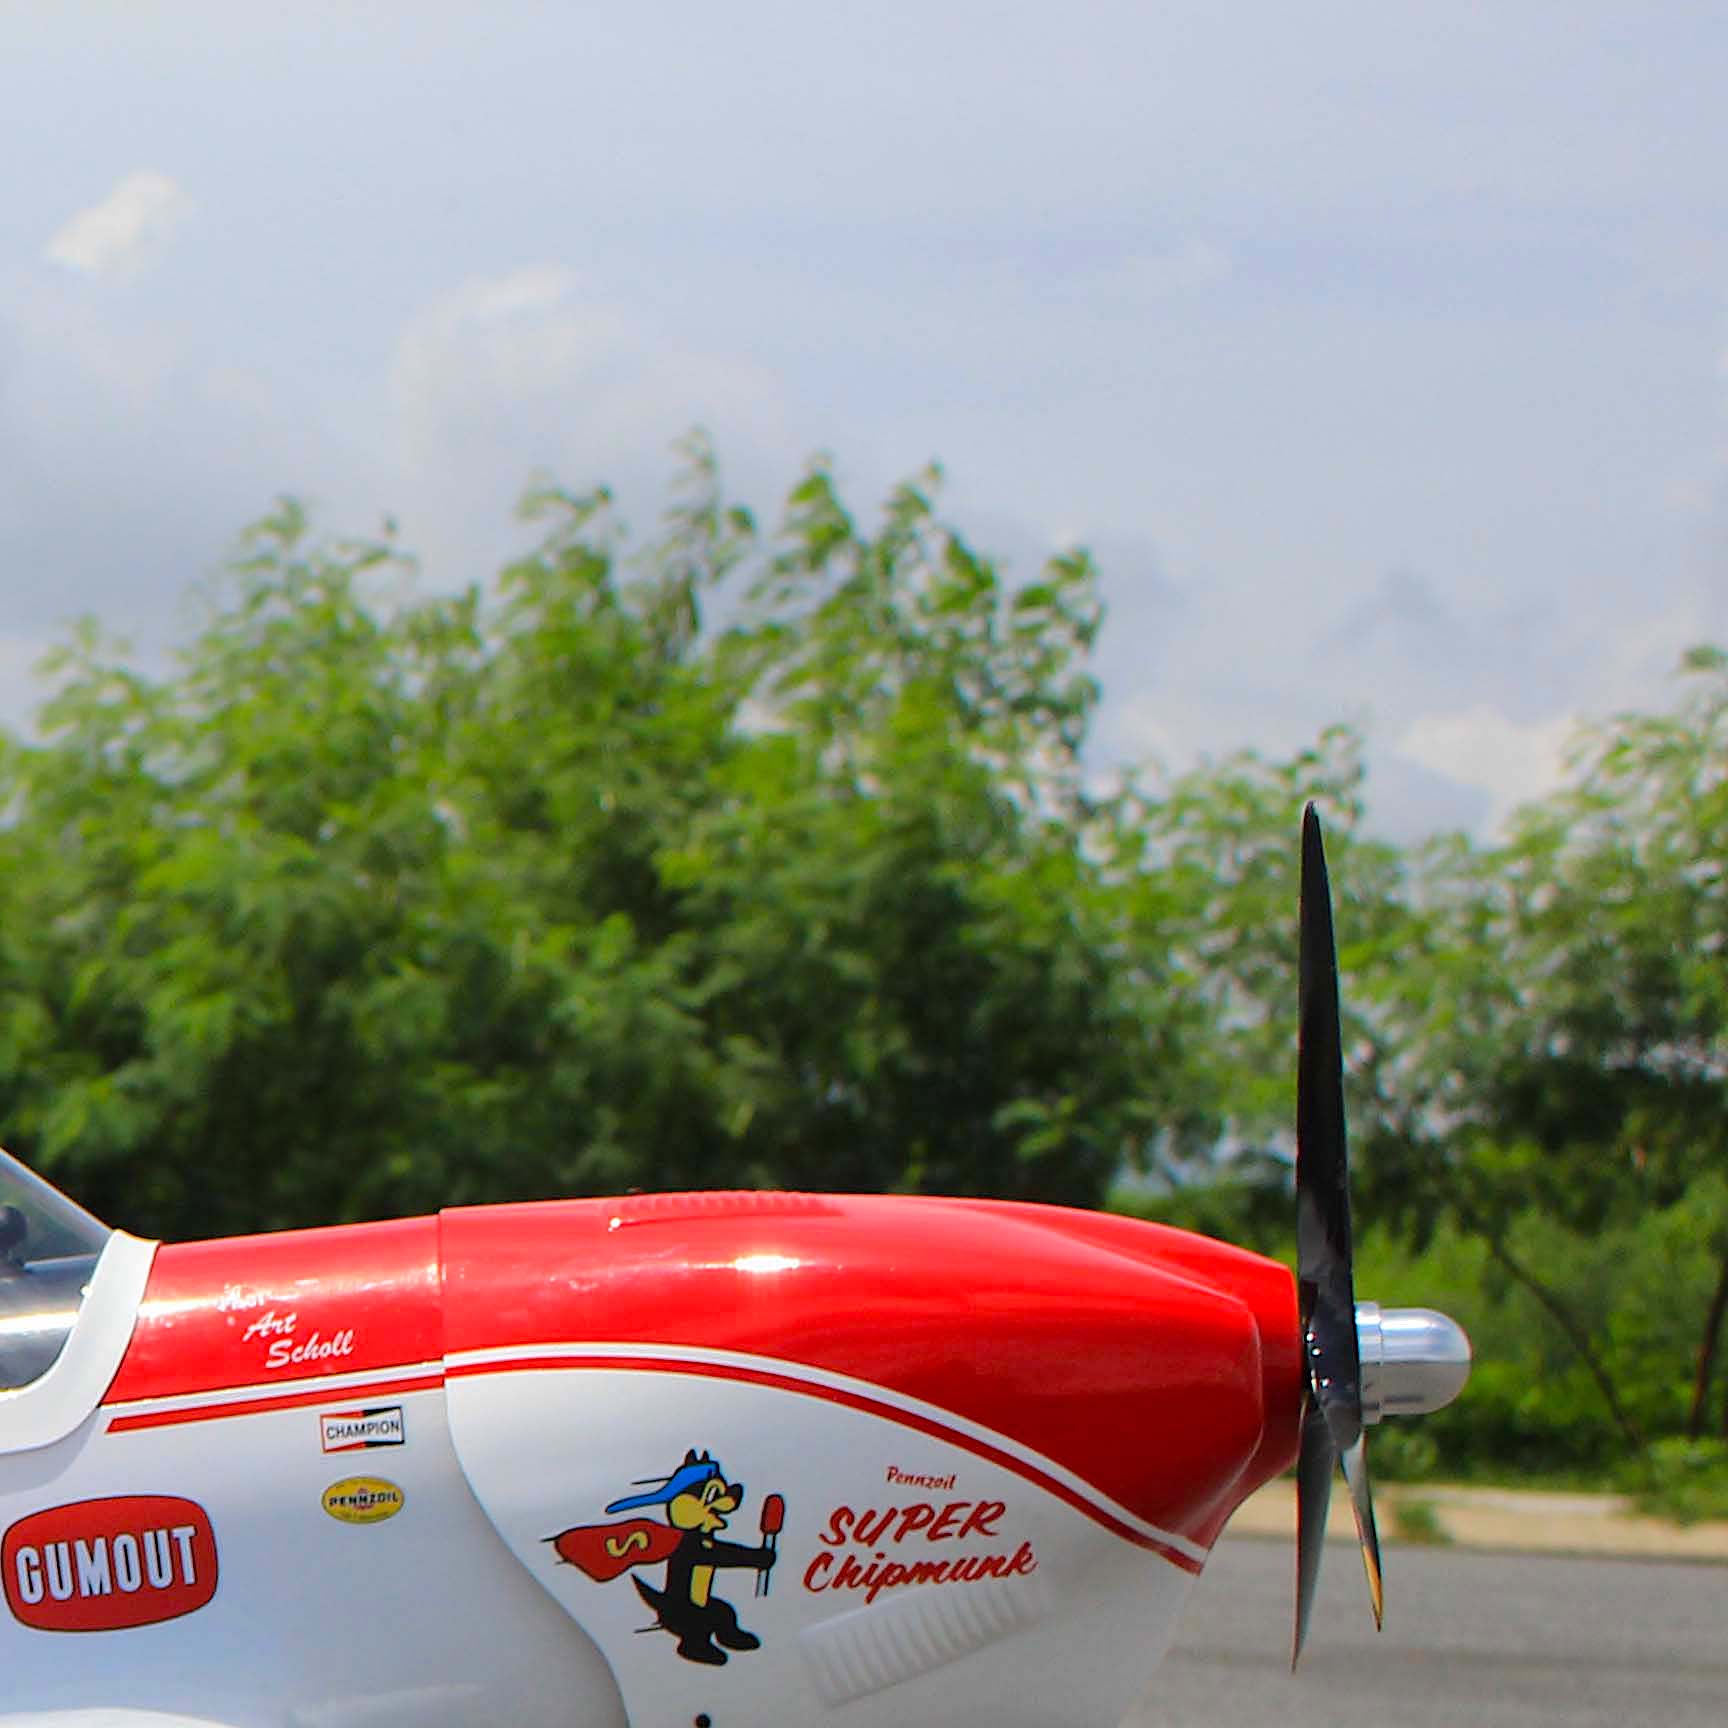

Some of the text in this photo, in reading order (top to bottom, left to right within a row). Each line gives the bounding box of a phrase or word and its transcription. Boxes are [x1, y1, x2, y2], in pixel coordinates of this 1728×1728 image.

[242, 1311, 297, 1341] Art
[265, 1330, 354, 1368] Scholl
[327, 1421, 399, 1440] CHAMPION
[819, 1501, 1007, 1547] SUPER
[15, 1524, 197, 1605] GUMOUT
[802, 1540, 1039, 1604] Chipmunk
